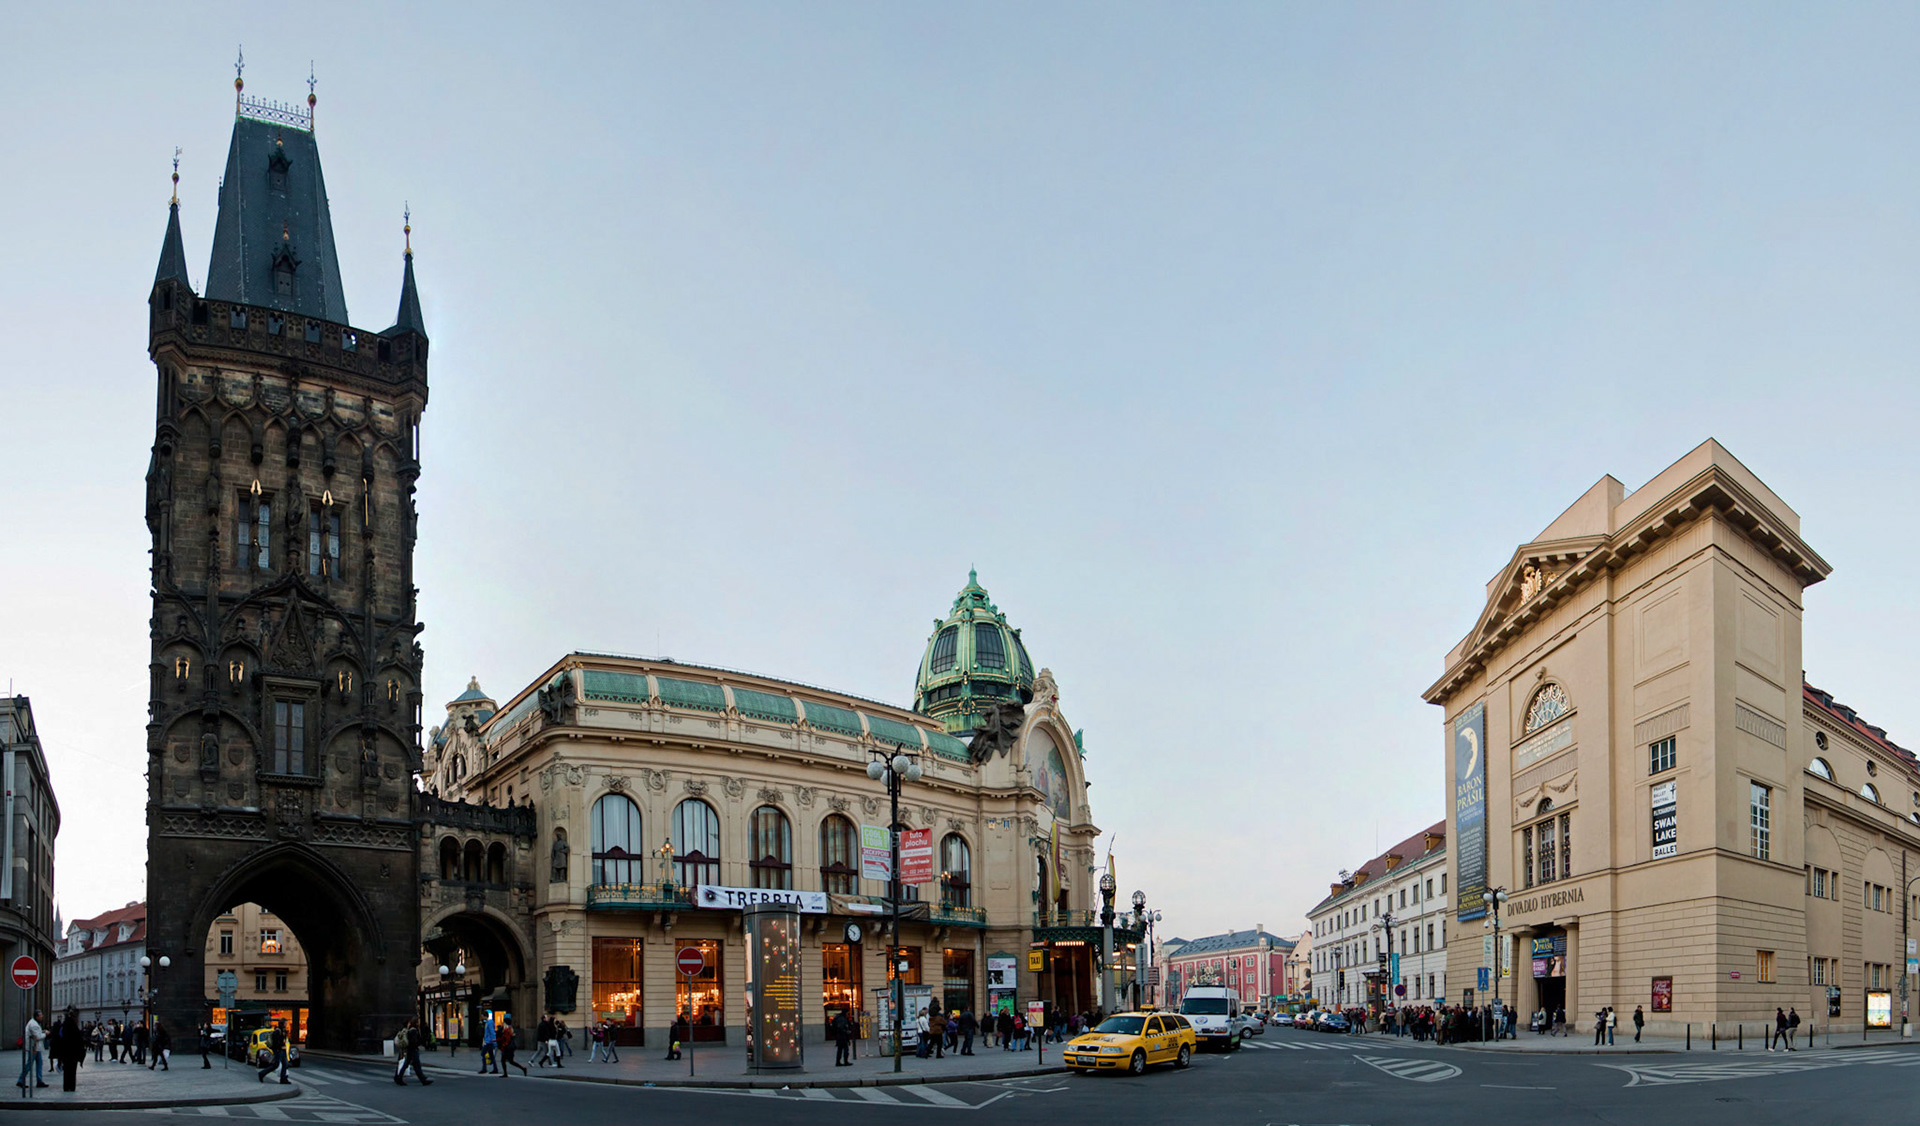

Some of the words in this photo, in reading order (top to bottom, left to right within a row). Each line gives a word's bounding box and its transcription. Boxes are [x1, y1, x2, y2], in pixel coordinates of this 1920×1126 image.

[1458, 774, 1482, 796] BARON
[1654, 815, 1676, 830] SWAN
[909, 831, 922, 839] tuto
[1655, 828, 1676, 842] LAKE
[905, 838, 928, 848] plochu
[1507, 897, 1538, 916] DIVADLO
[1540, 887, 1584, 910] HYBERNIA
[1030, 956, 1041, 965] TAXI
